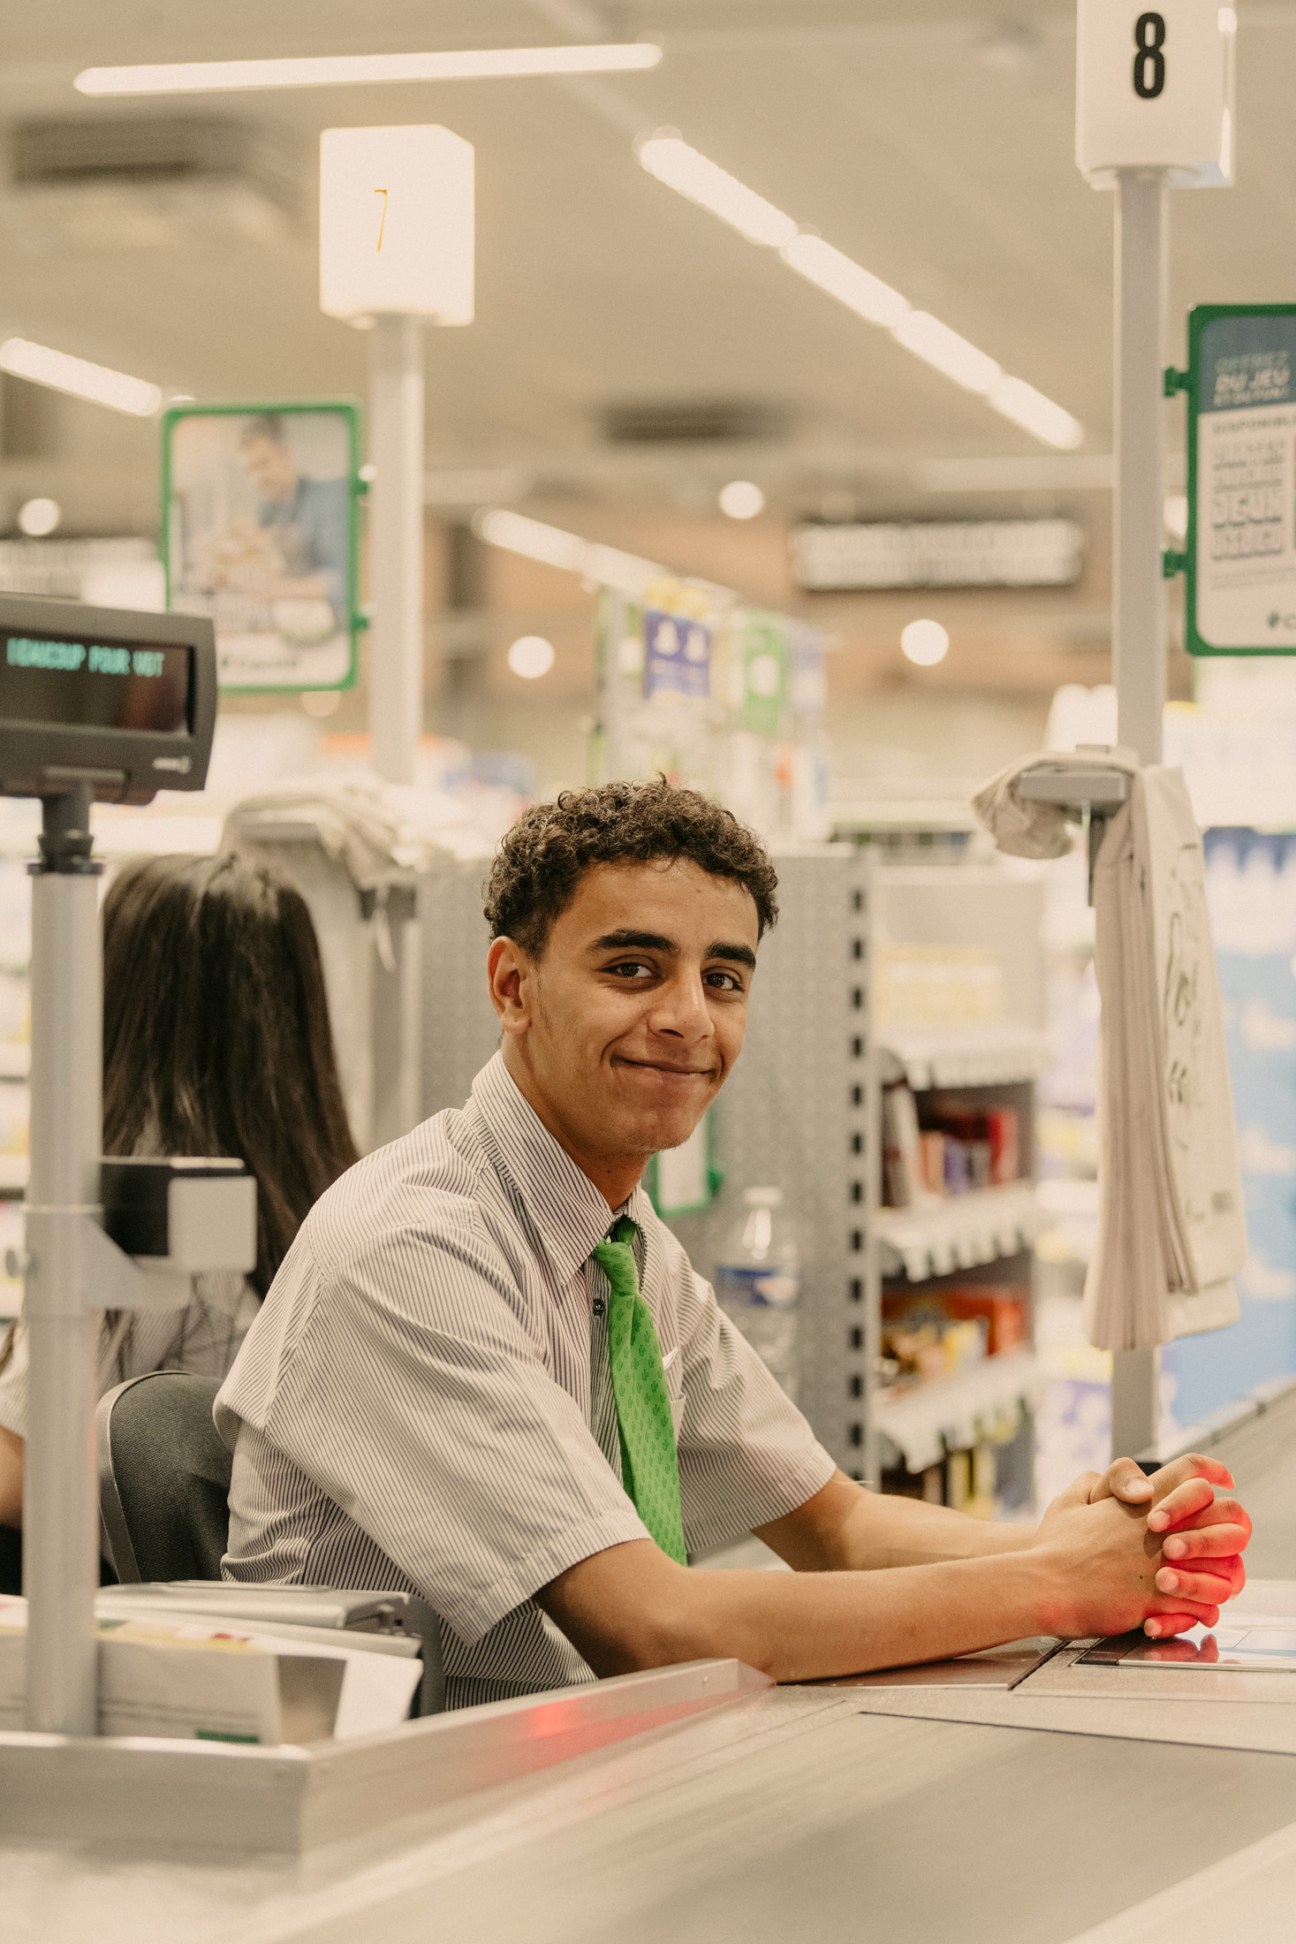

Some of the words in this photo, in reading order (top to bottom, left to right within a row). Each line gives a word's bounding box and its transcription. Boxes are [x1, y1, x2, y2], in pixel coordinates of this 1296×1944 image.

[1133, 12, 1165, 99] 8
[372, 188, 388, 253] 7
[1215, 373, 1248, 394] DU
[1248, 367, 1291, 389] JEU
[88, 645, 130, 675] POUR
